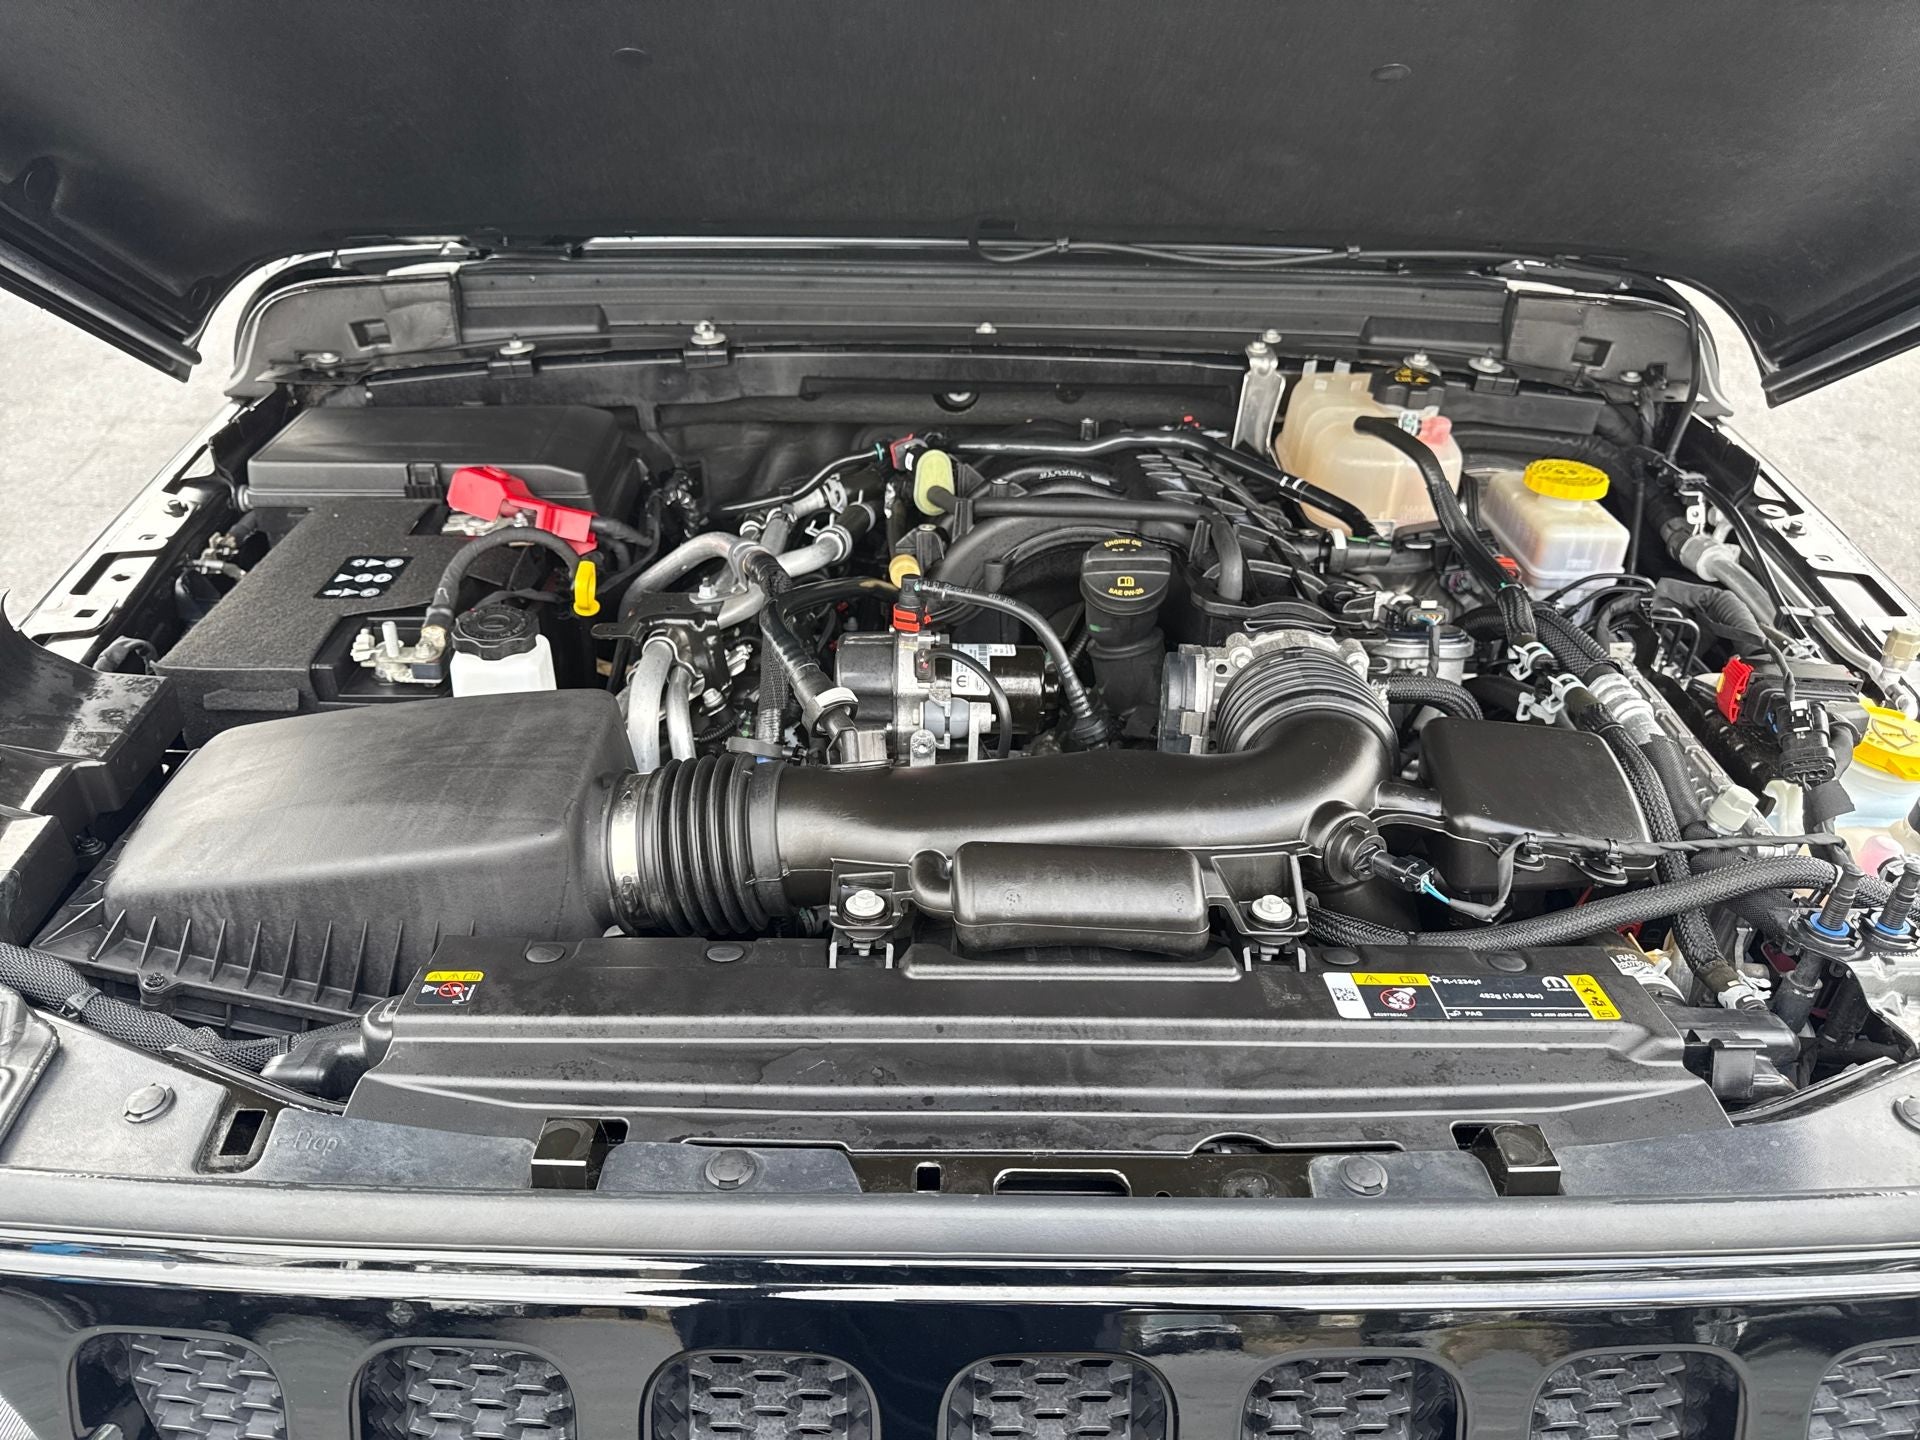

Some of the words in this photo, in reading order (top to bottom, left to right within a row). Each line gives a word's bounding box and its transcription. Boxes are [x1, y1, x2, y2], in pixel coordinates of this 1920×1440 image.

[1104, 539, 1131, 548] ENGINE
[1131, 539, 1142, 547] OIL
[1108, 587, 1123, 596] SAE
[1616, 953, 1638, 962] RAD
